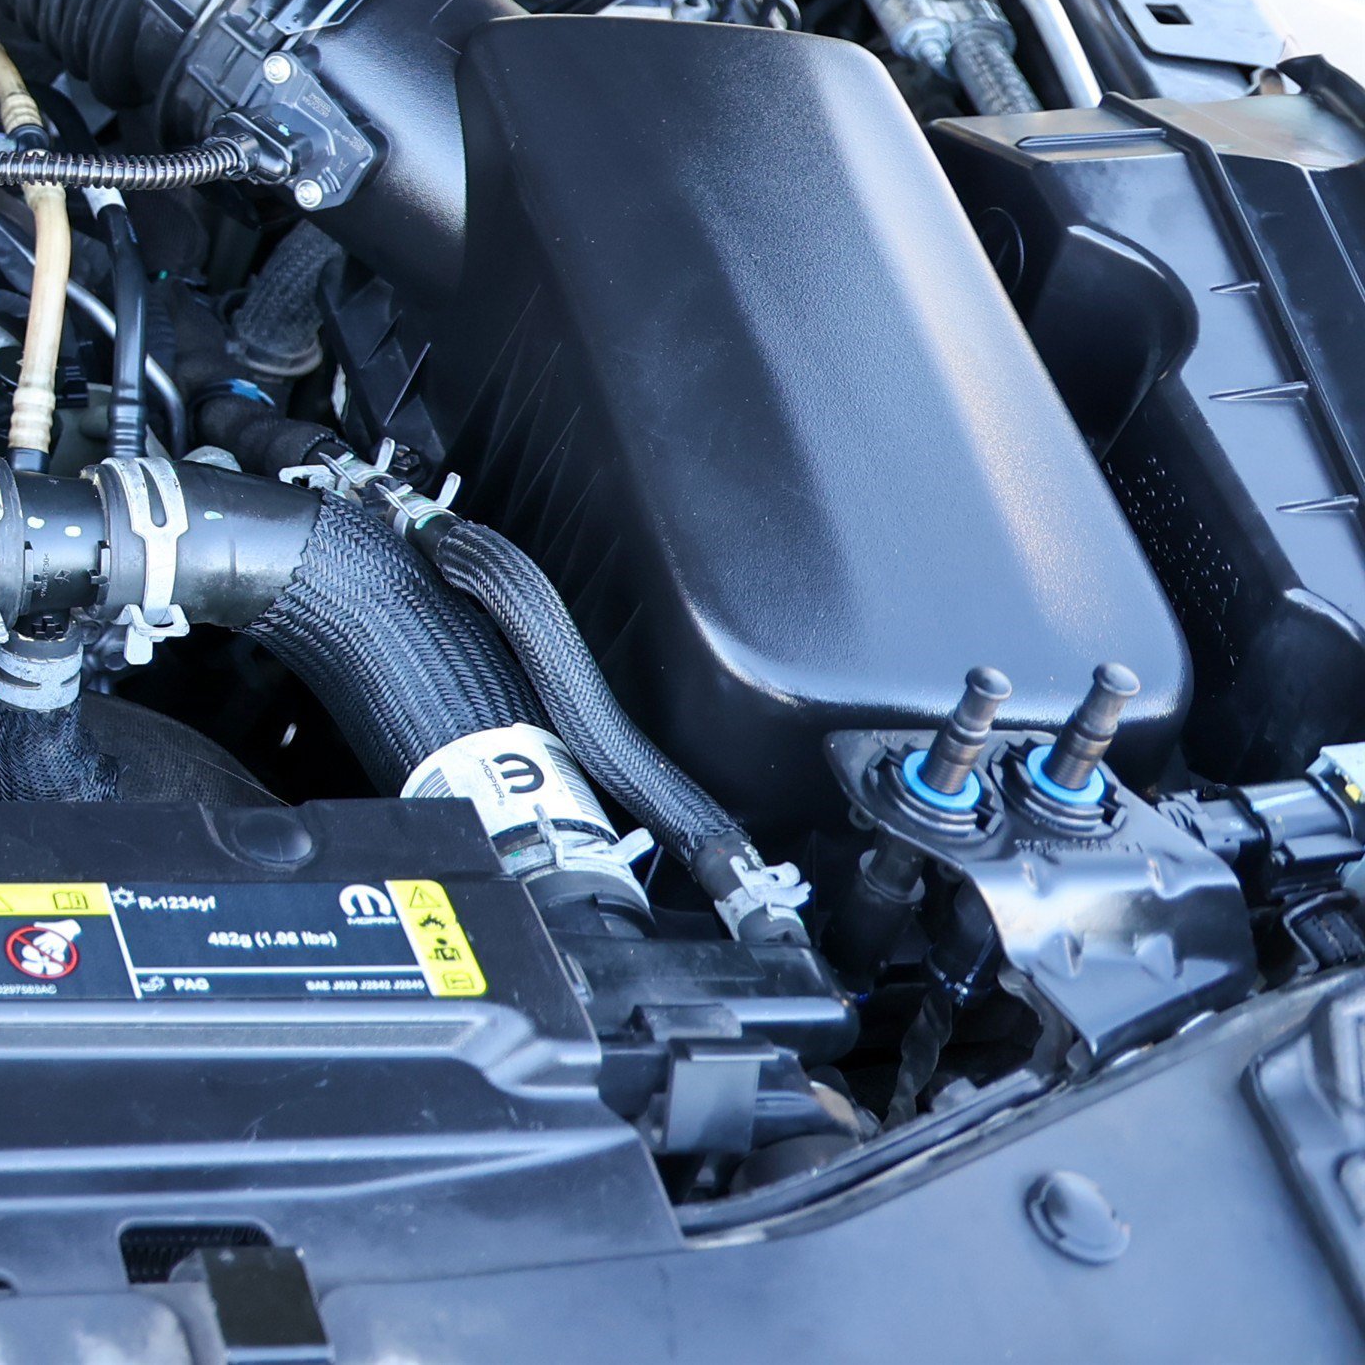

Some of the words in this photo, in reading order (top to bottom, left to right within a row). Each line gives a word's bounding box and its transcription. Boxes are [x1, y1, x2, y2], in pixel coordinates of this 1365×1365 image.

[479, 758, 506, 801] MOPAR
[300, 931, 338, 949] lbs)
[173, 976, 210, 992] PAG
